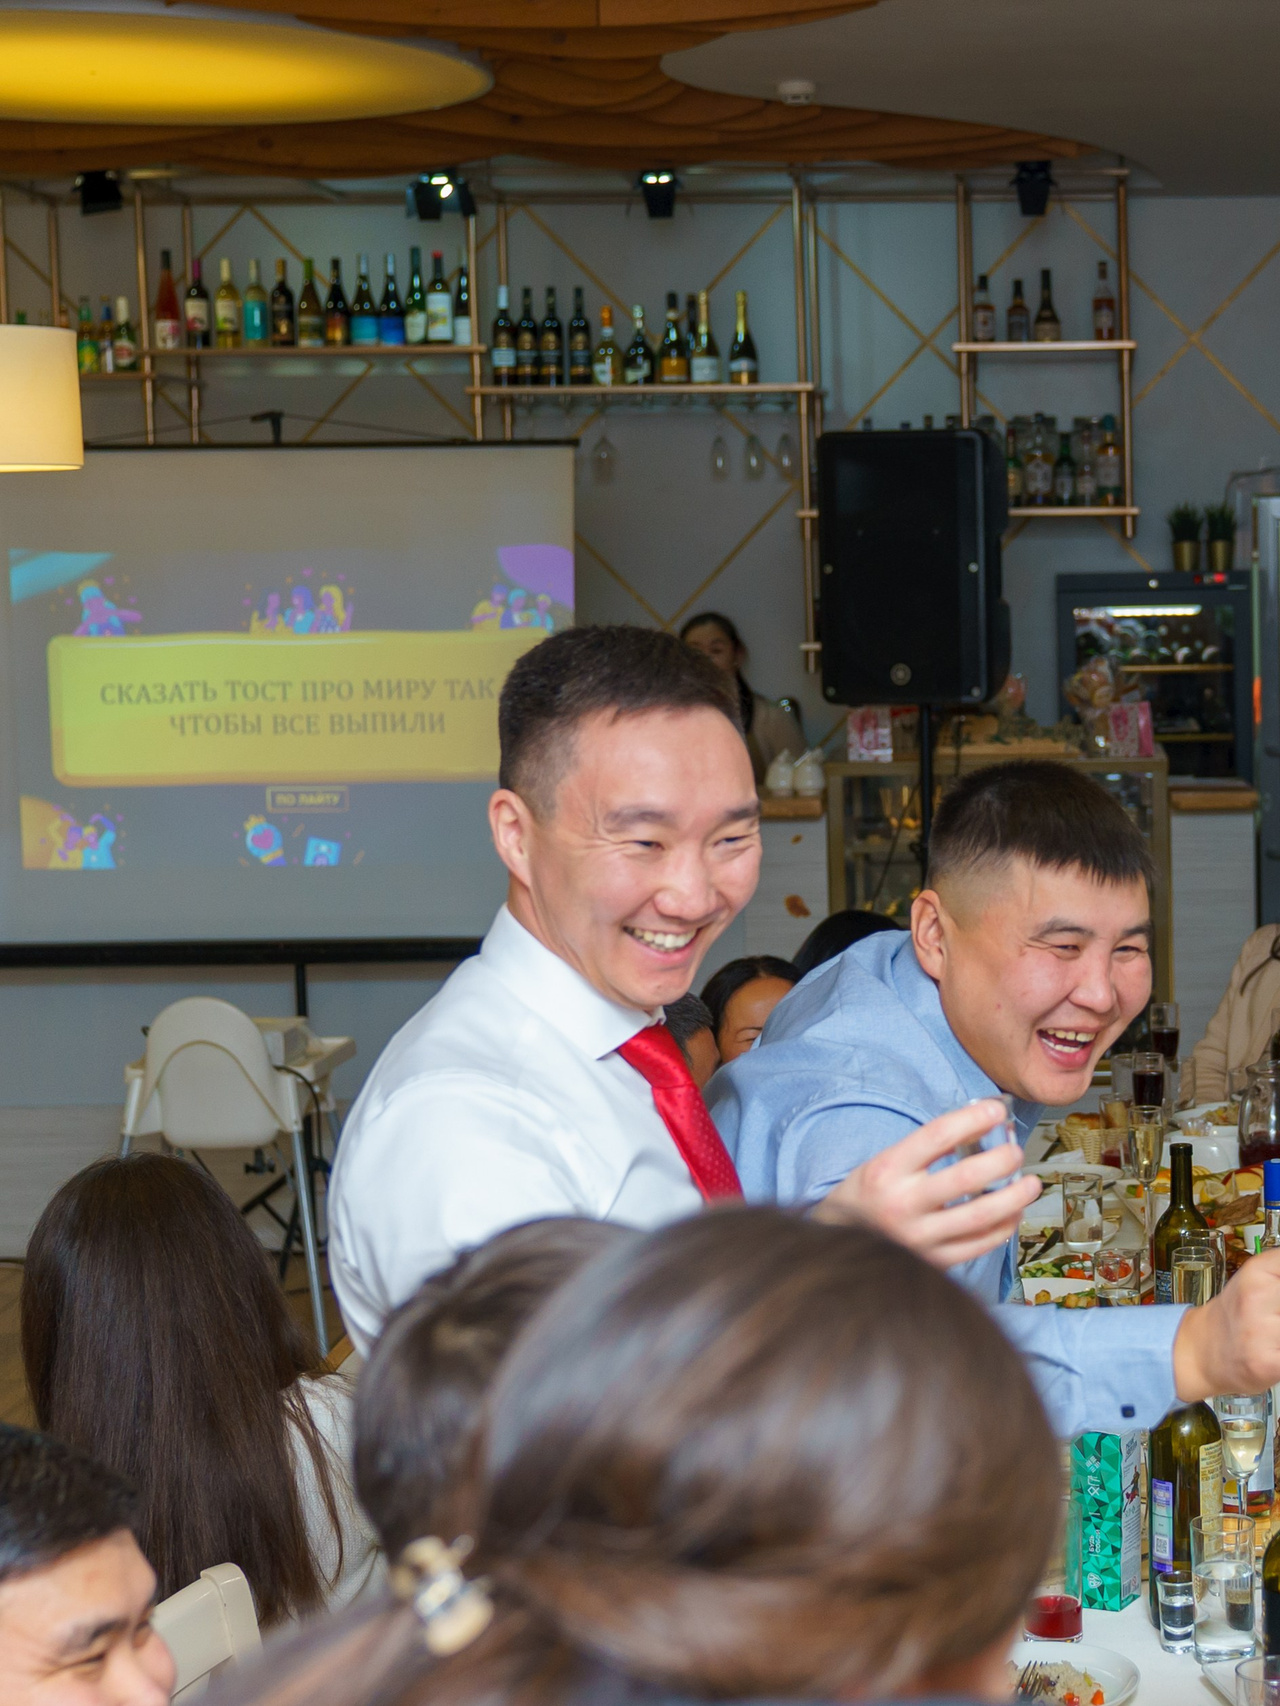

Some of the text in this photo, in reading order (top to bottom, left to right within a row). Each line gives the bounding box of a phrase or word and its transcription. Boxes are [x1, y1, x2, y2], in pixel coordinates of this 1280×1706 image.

[100, 677, 496, 705] СКАЗАТЬ ТОСТ ПРО МИРУ ТАК
[169, 710, 447, 737] ЧТОБЫ ВСЕ ВЫПИЛИ
